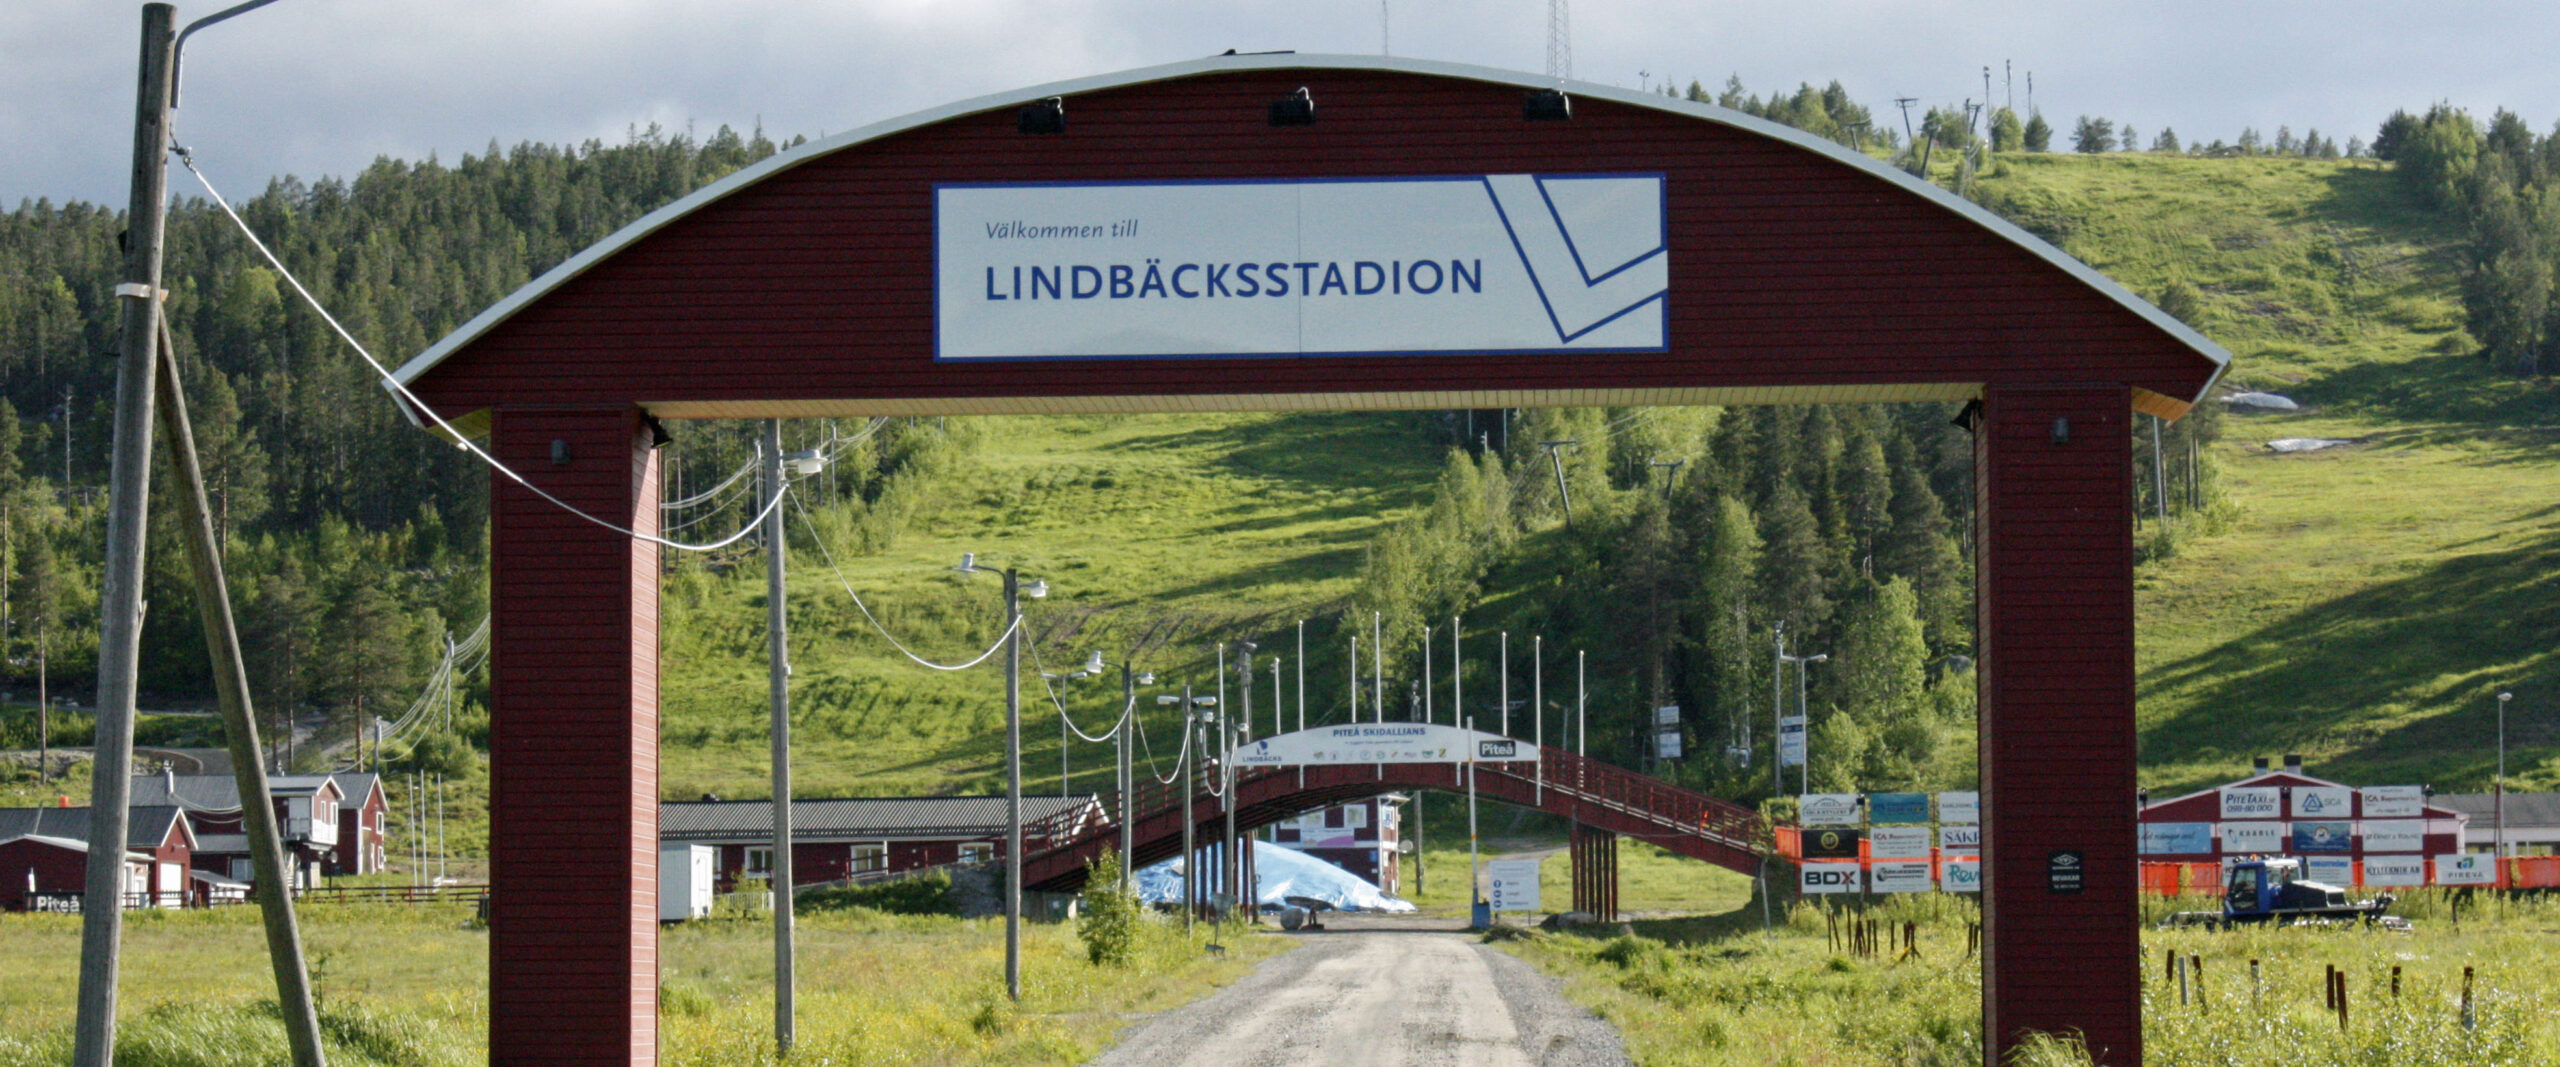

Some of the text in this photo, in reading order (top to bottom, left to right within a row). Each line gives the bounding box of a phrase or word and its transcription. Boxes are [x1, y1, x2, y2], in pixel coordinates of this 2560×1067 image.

[986, 219, 1138, 239] Välkommen till
[986, 259, 1482, 301] LINDBÄCKSSTADION
[1333, 727, 1426, 736] PITEÅ SKIDALLIANS
[1482, 743, 1513, 755] Piteå
[1805, 871, 1856, 885] BDX
[37, 894, 80, 912] Piteå
